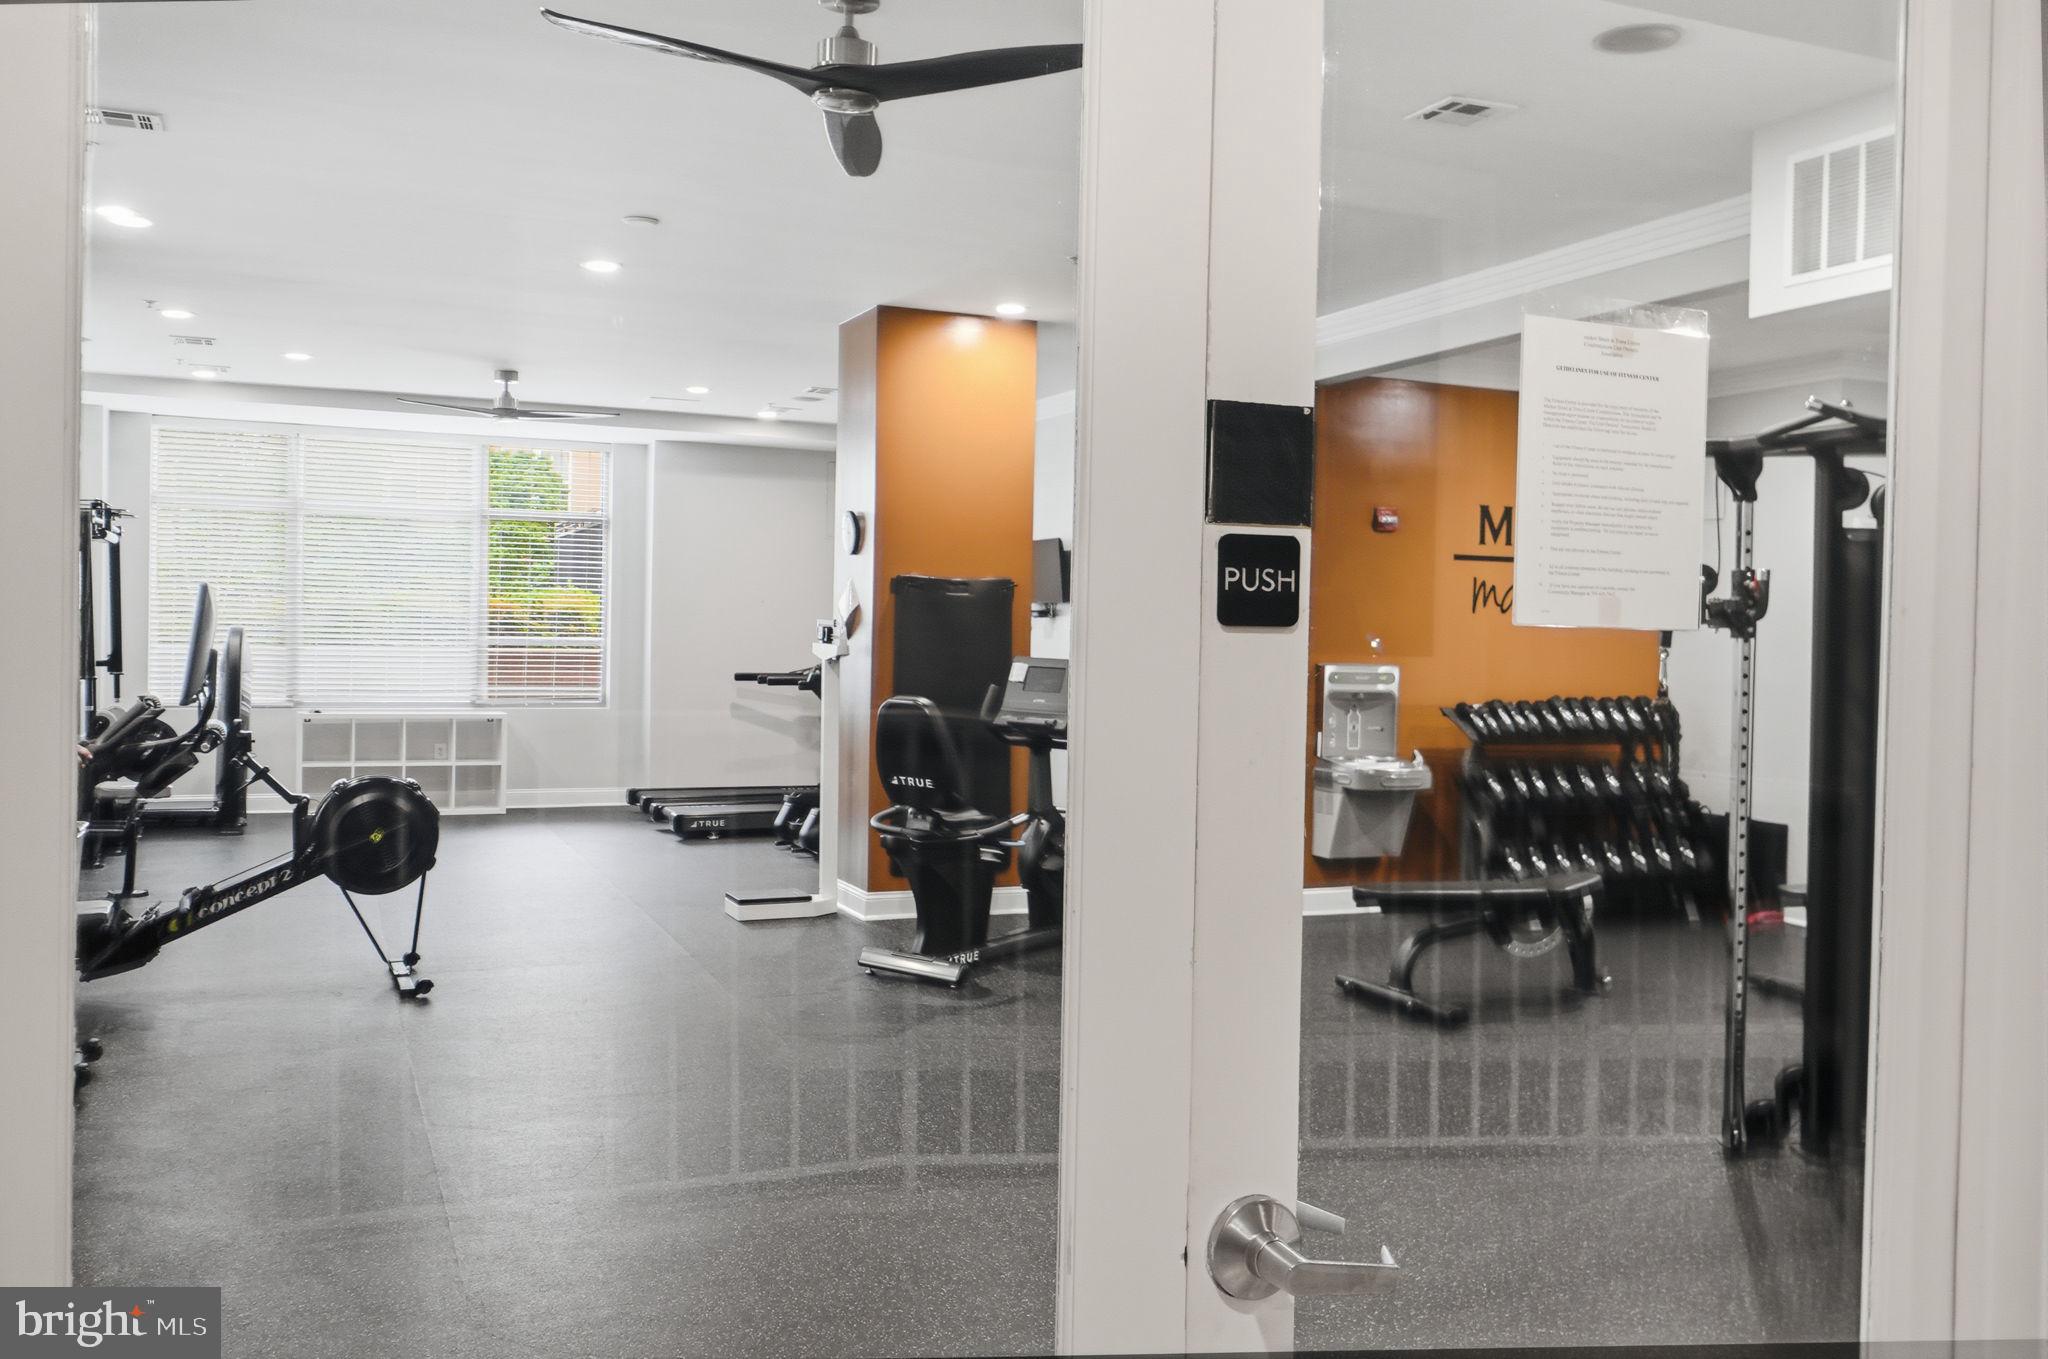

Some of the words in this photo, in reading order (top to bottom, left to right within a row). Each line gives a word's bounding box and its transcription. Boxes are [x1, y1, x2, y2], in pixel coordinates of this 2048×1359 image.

[1224, 567, 1296, 593] PUSH
[898, 775, 935, 789] TRUE
[699, 819, 726, 828] TRUE
[198, 875, 279, 918] concept
[953, 950, 980, 964] TRUE
